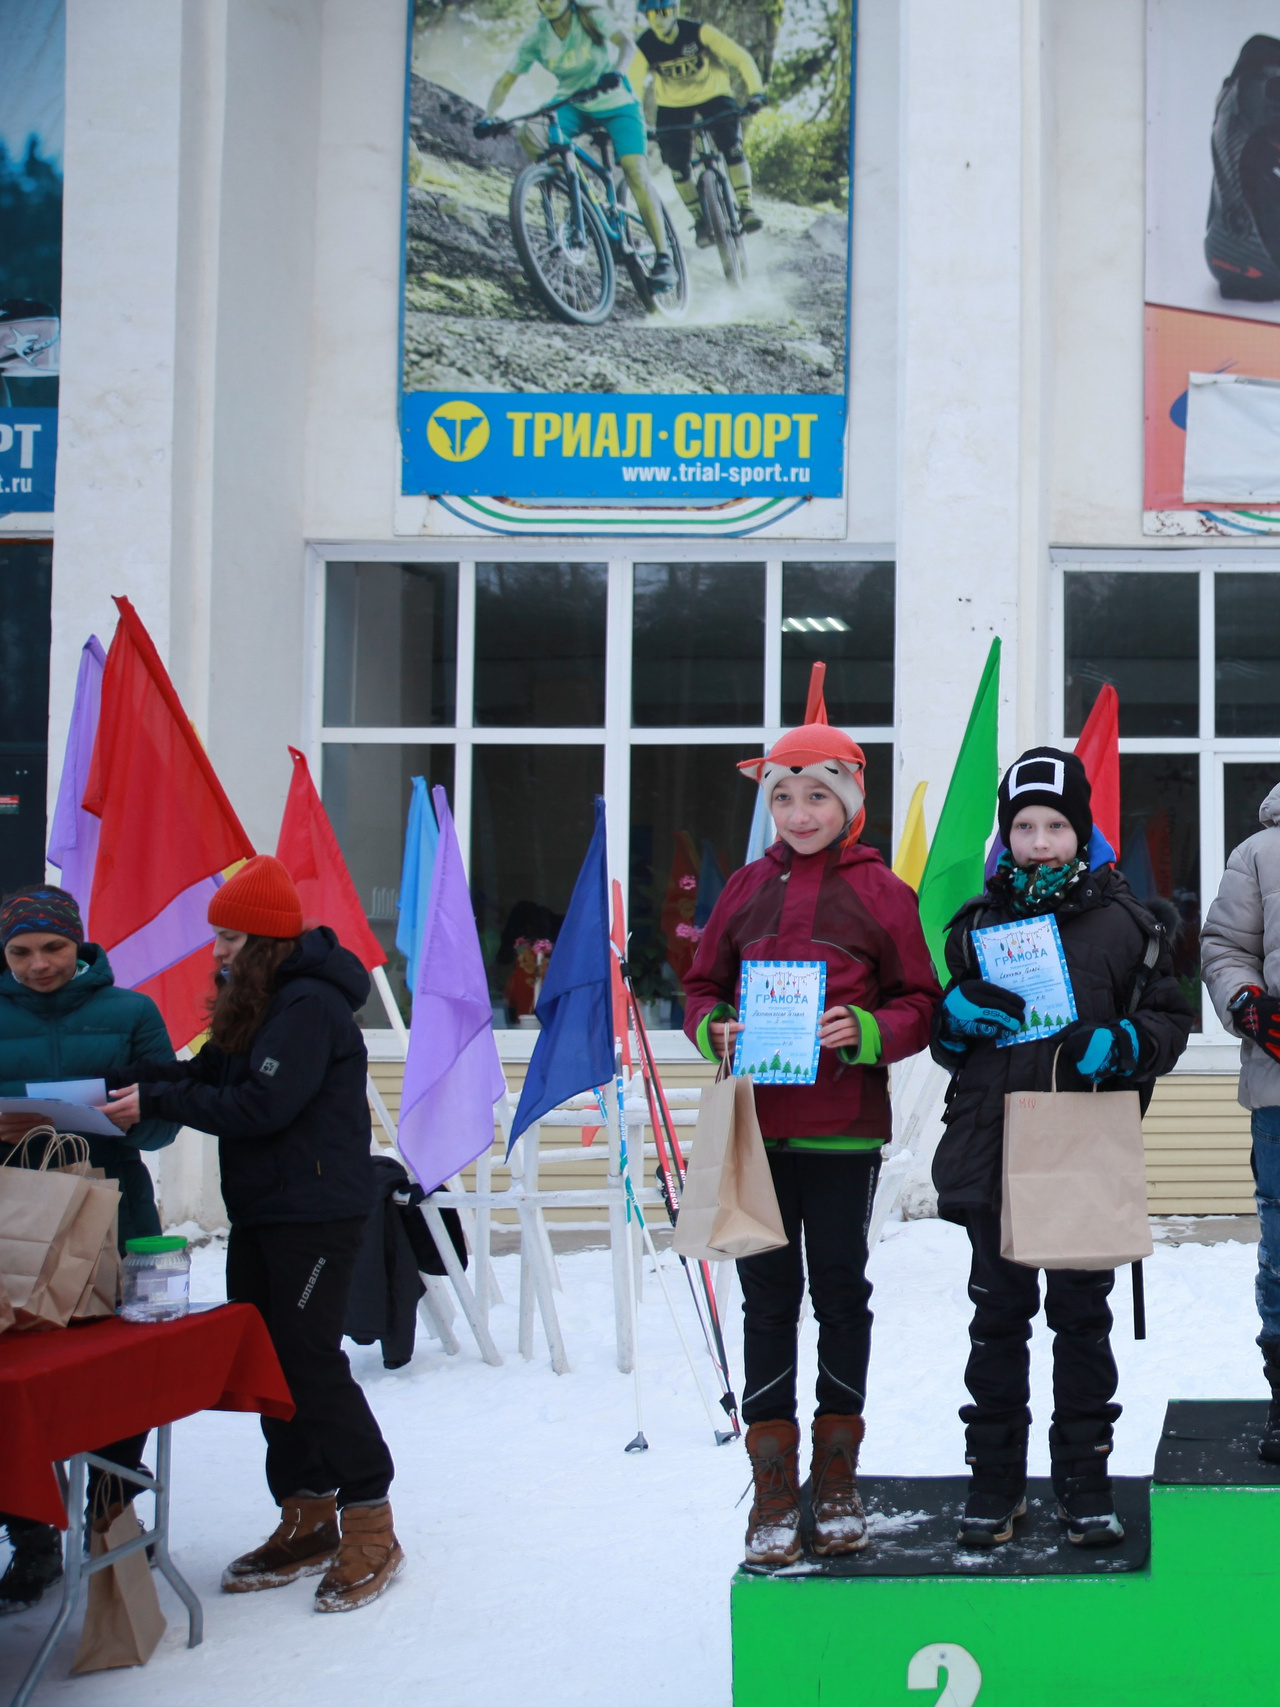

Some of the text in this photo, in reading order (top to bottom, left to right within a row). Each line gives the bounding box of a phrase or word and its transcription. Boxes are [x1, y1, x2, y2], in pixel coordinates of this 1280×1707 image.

[622, 462, 811, 487] www.trial-sport.ru
[994, 947, 1048, 967] ГРАМОТА
[755, 994, 809, 1004] ГРАМОТА
[664, 1170, 681, 1211] NORDWAY
[297, 1256, 327, 1310] noname
[906, 1642, 982, 1707] 2
